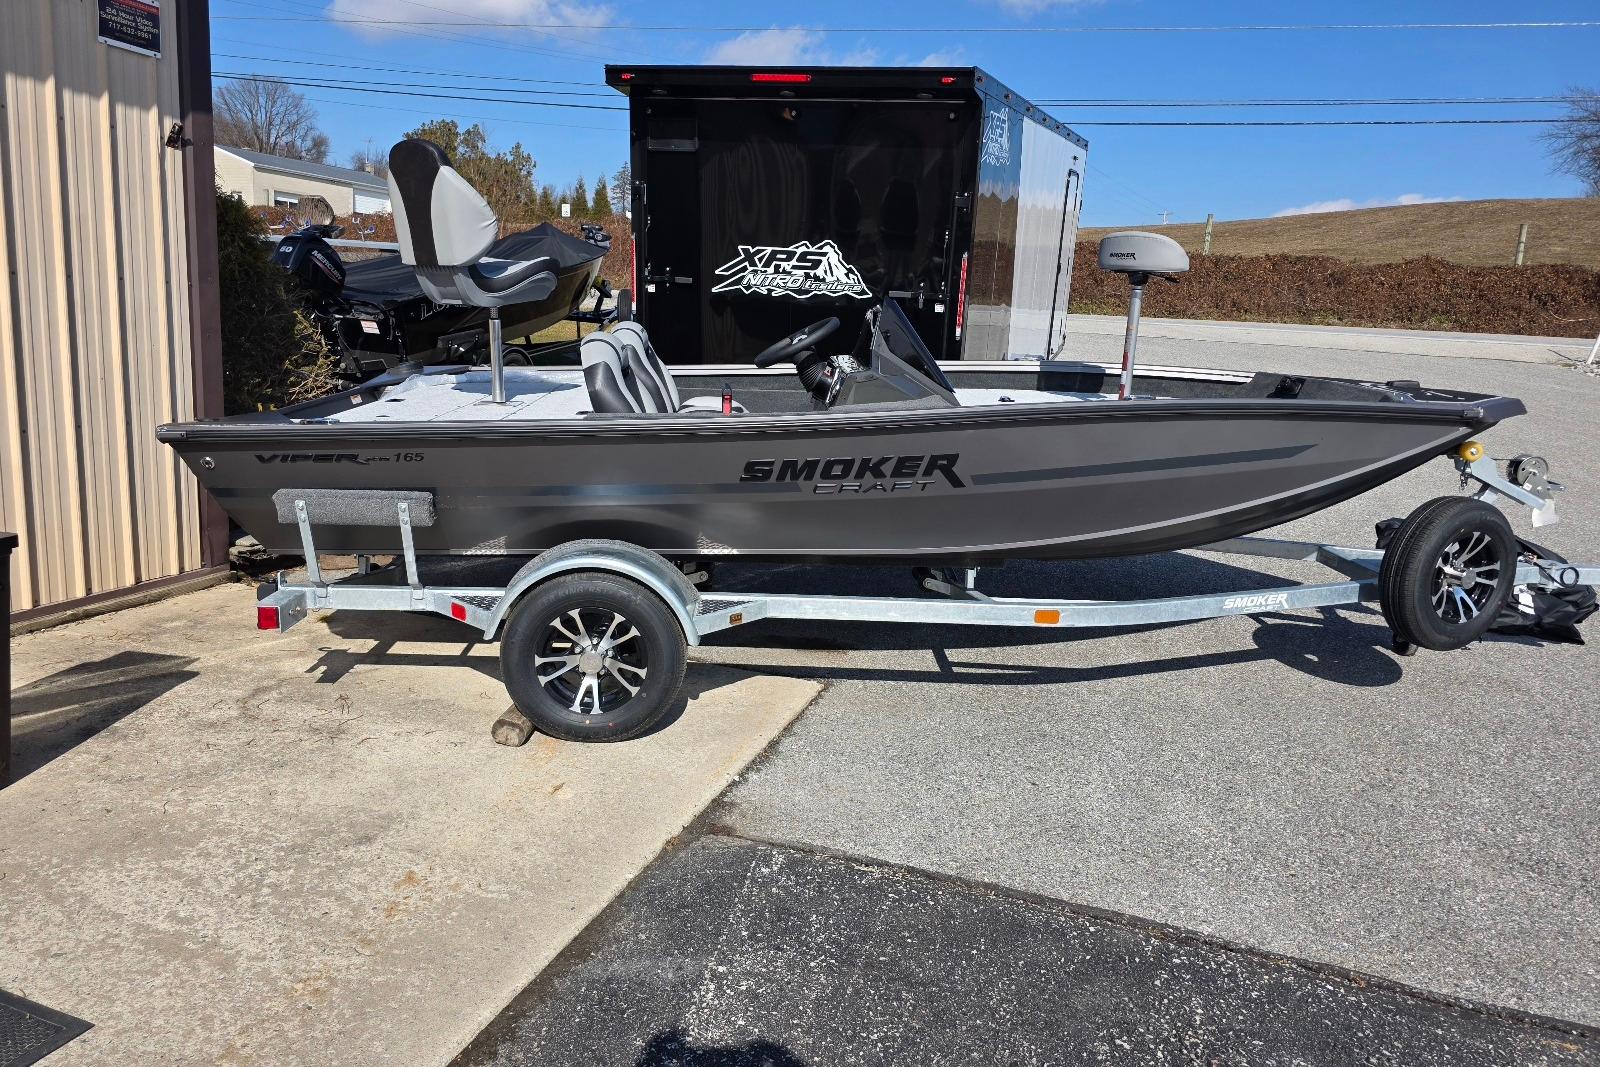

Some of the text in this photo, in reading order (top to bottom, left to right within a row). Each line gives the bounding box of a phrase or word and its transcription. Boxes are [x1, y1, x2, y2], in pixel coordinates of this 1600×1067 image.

[105, 6, 117, 16] 24
[119, 11, 134, 20] Hour
[135, 15, 153, 27] Video
[137, 22, 159, 34] System
[715, 245, 830, 275] XPS
[1109, 252, 1136, 260] SMOKER
[311, 250, 343, 281] MERCURY
[741, 271, 804, 289] NITRO
[254, 453, 370, 465] VIPER
[394, 452, 425, 463] 165
[739, 453, 967, 488] SMOKER
[813, 480, 936, 495] CRAFT
[1222, 592, 1289, 609] SMOKER
[1243, 604, 1281, 613] CRAFT
